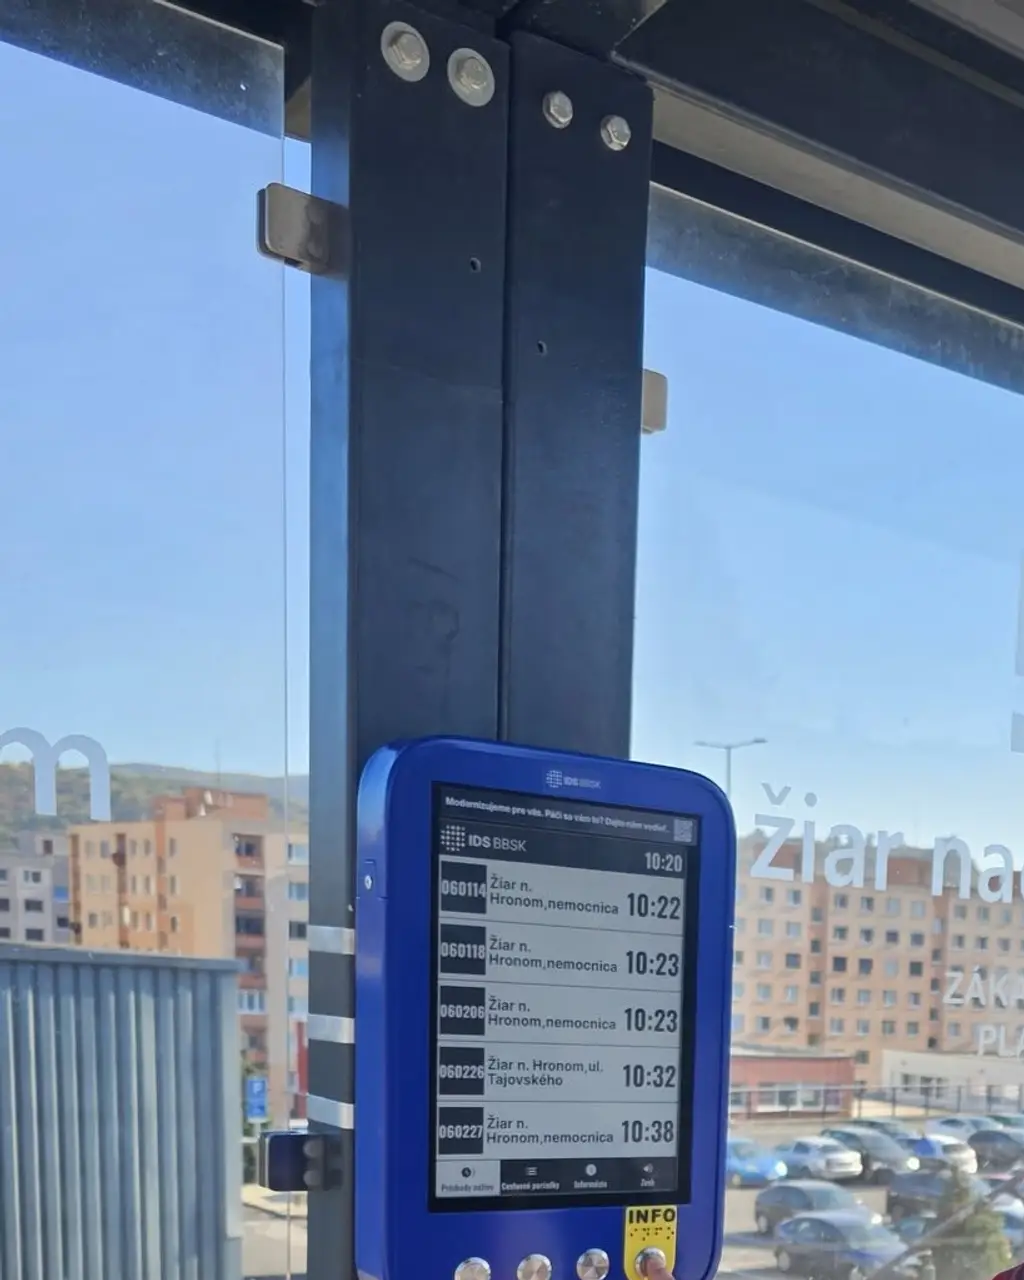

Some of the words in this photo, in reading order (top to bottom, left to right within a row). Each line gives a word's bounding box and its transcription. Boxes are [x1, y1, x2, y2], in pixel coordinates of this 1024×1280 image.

[468, 834, 491, 849] IDS
[493, 838, 527, 852] BBSK
[750, 782, 904, 892] žiar
[645, 852, 683, 873] 10:20
[441, 879, 487, 899] 060114
[490, 873, 517, 891] Žiar
[520, 880, 532, 892] n.
[627, 892, 681, 920] 10:22
[440, 942, 486, 960] 060118
[489, 935, 515, 952] Žiar
[519, 941, 531, 953] n.
[626, 950, 680, 977] 10:23
[440, 1004, 485, 1019] 060206
[488, 995, 514, 1012] Žiar
[518, 1001, 530, 1013] n.
[624, 1008, 678, 1033] 10:23
[439, 1065, 484, 1080] 060226
[488, 1056, 514, 1072] Žiar
[517, 1061, 529, 1072] n.
[488, 1073, 563, 1088] Tajovského
[623, 1064, 676, 1088] 10:32
[487, 1115, 513, 1130] Žiar
[516, 1119, 529, 1130] n.
[622, 1120, 675, 1143] 10:38
[439, 1124, 483, 1140] 060227
[628, 1208, 676, 1224] INFO
